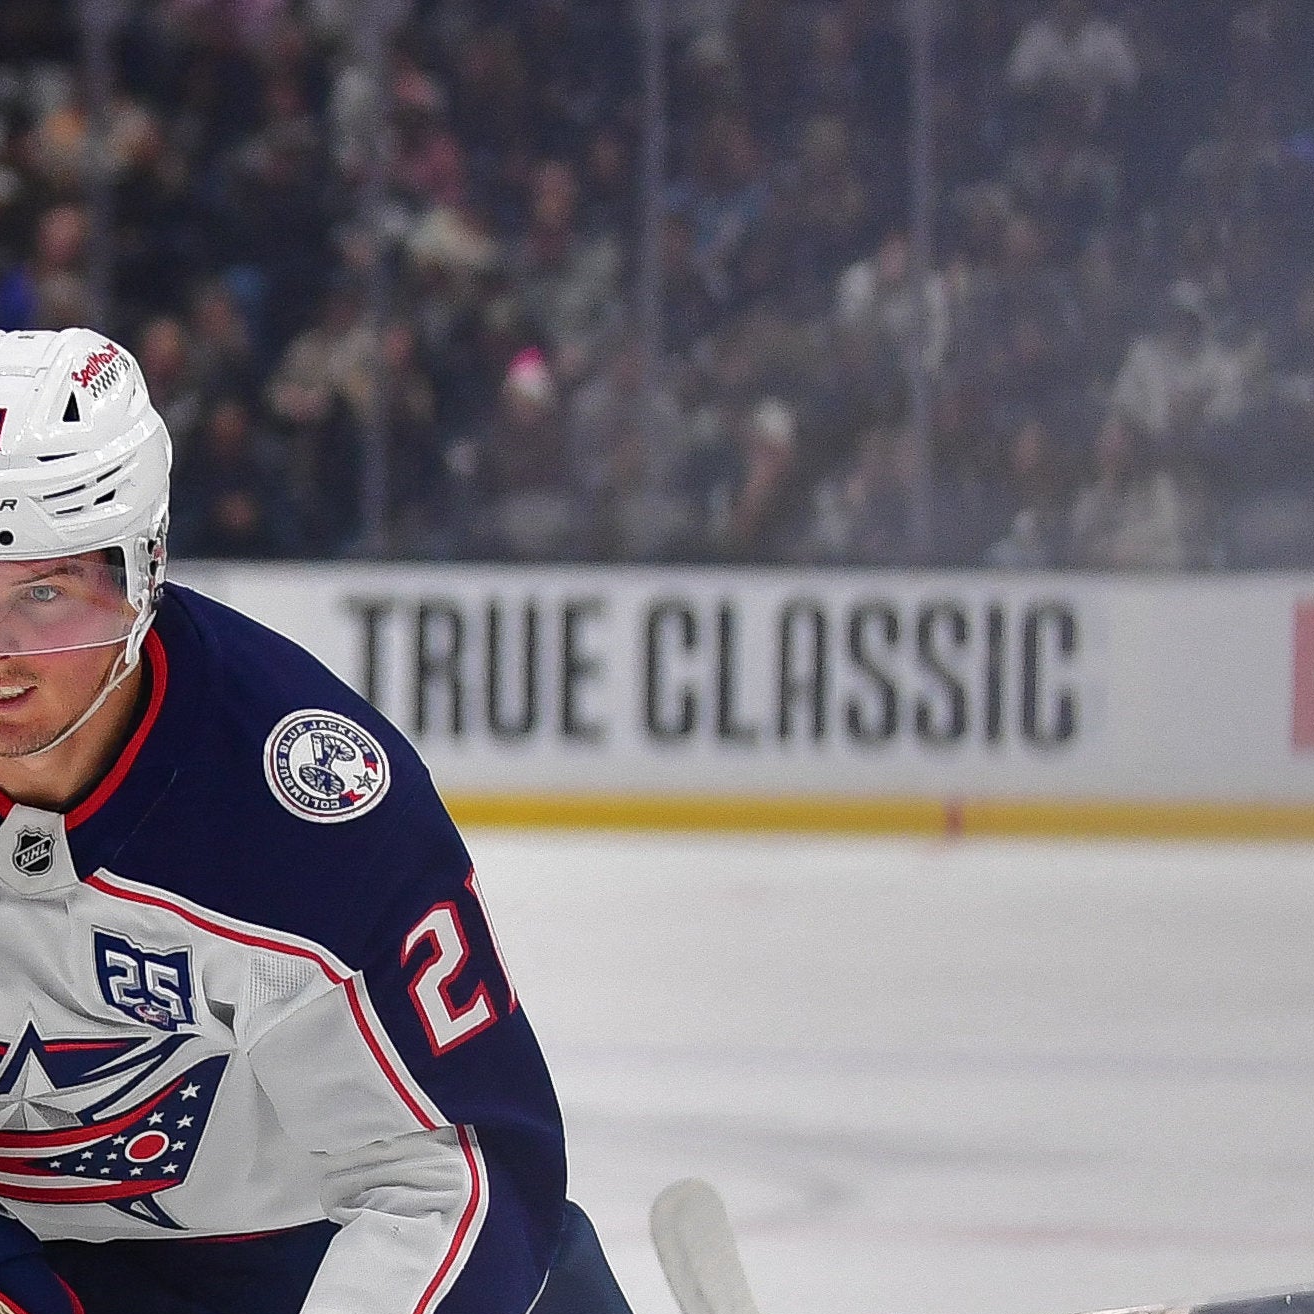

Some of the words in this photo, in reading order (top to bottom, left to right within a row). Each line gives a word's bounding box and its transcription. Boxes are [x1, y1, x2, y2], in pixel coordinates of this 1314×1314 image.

[341, 597, 606, 741] TRUE
[644, 596, 1080, 748] CLASSIC
[279, 724, 307, 754] BLUE
[309, 720, 371, 755] JACKETS
[278, 757, 340, 809] COLUMBUS
[20, 843, 48, 866] NHL
[105, 949, 186, 1021] 25
